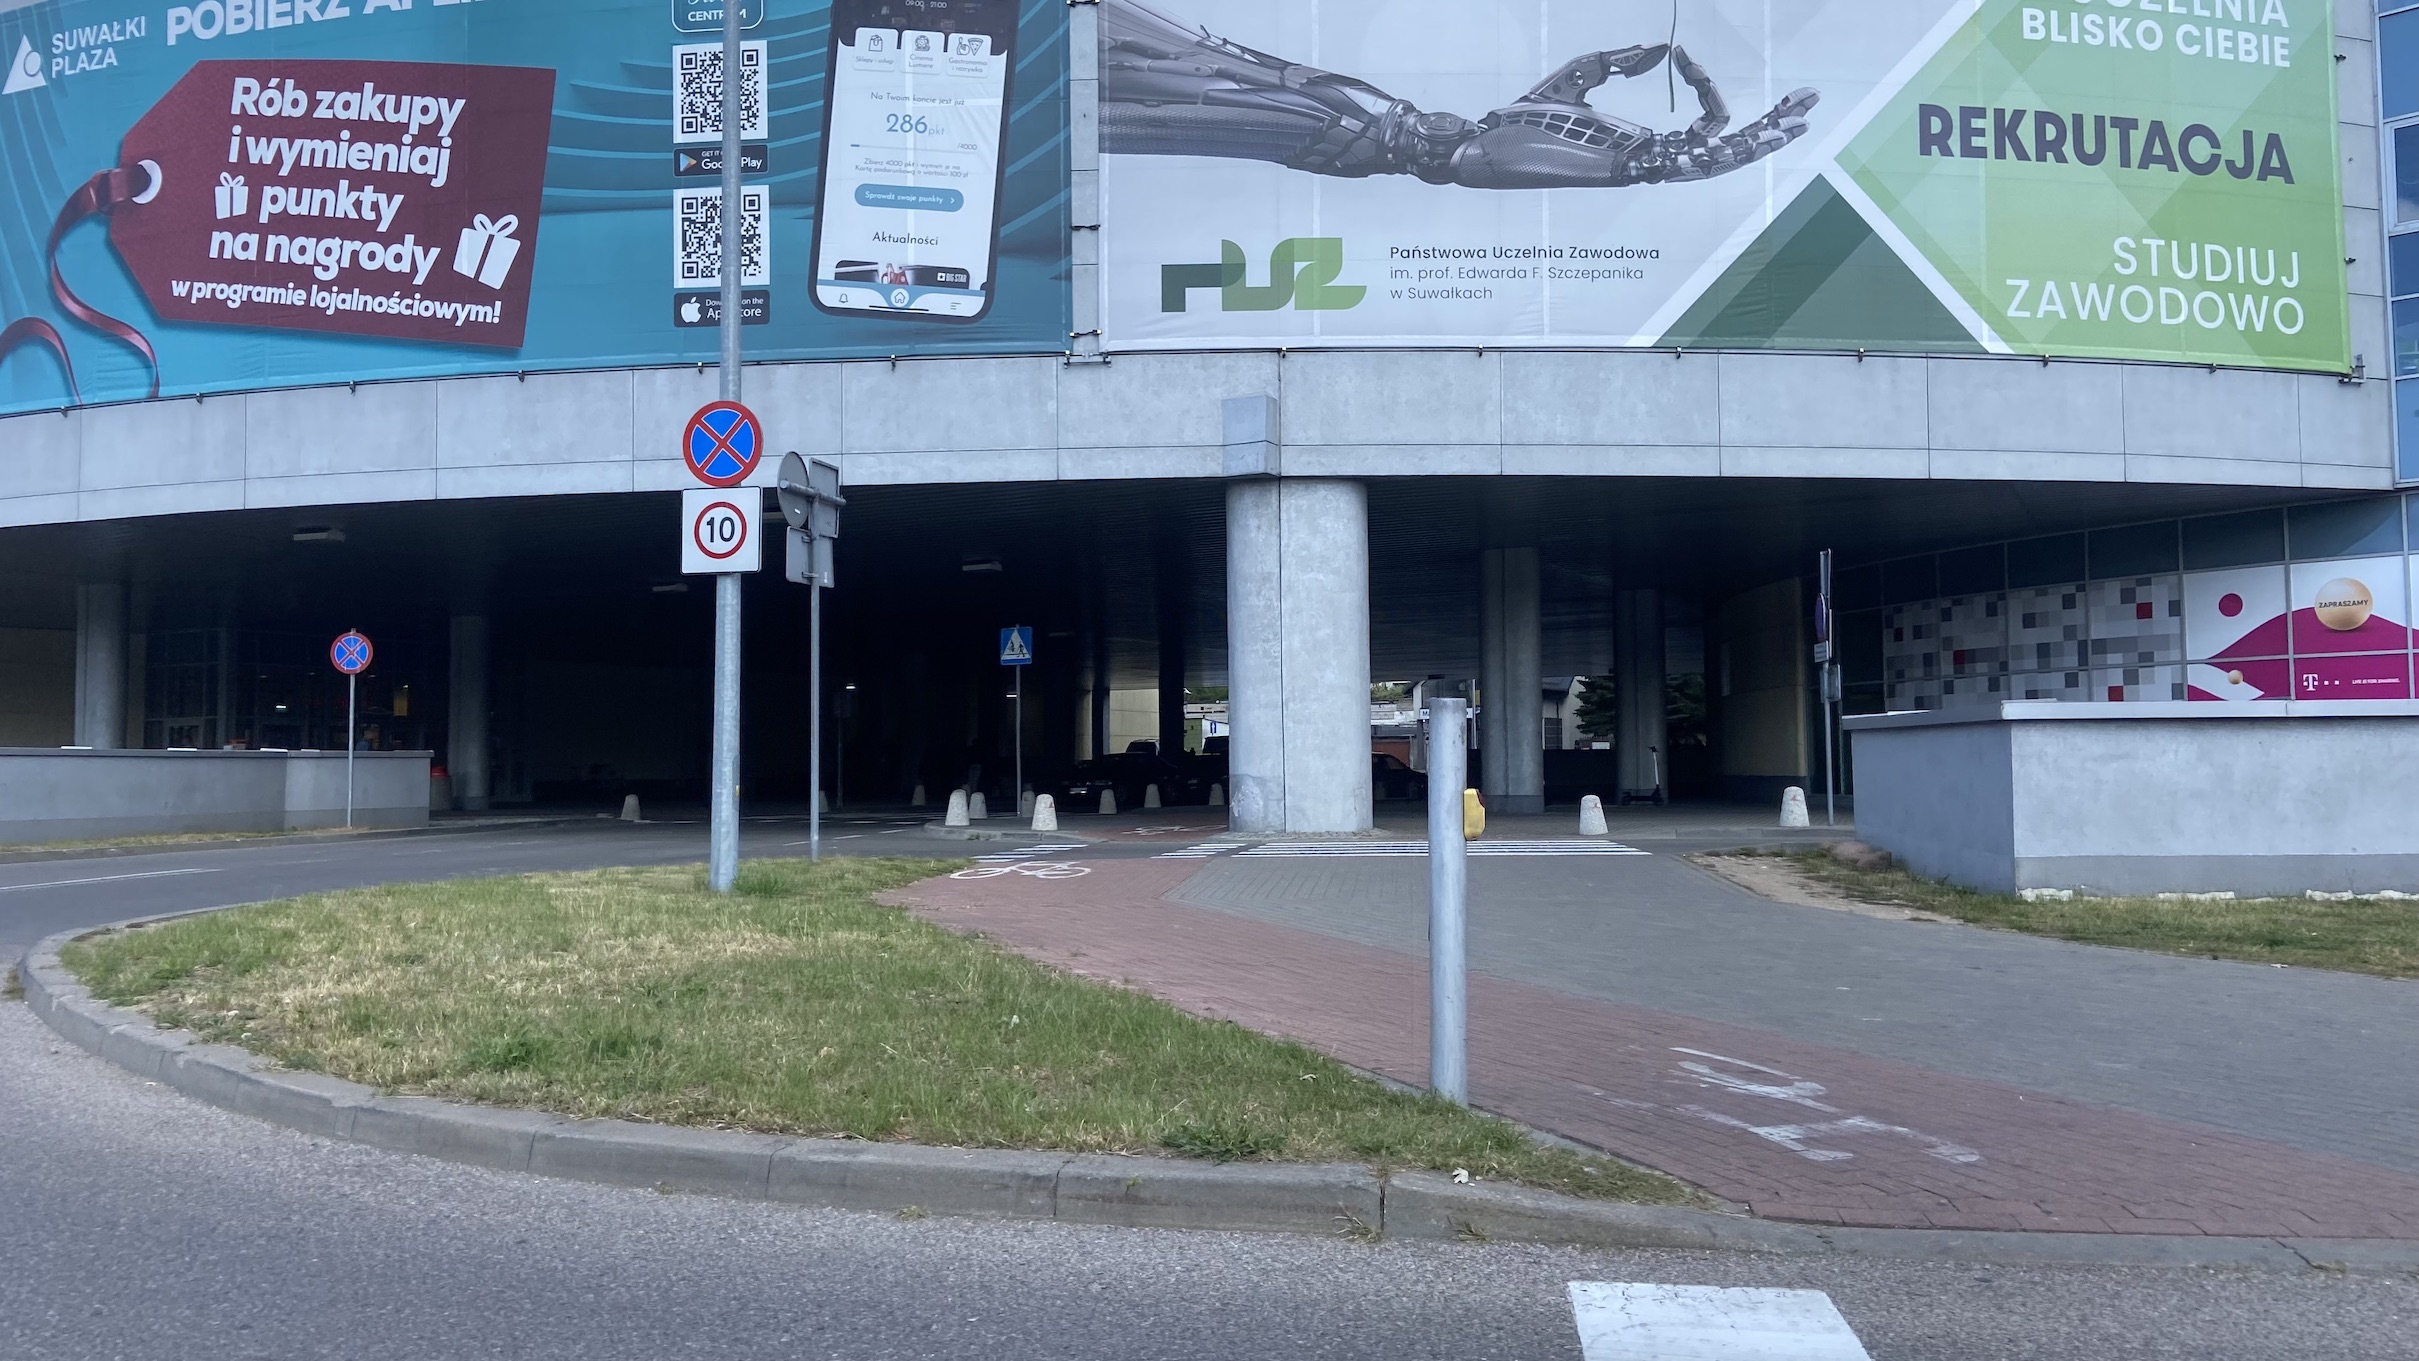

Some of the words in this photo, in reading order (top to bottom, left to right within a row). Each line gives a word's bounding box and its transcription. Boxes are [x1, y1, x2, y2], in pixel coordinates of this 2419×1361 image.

[51, 15, 145, 54] SUWAŁKI
[2023, 8, 2164, 51] BLISKO
[2176, 23, 2291, 67] CIEBIE
[51, 46, 118, 78] PLAZA
[230, 77, 308, 117] Rób
[312, 82, 467, 137] zakupy
[870, 92, 883, 100] Na
[886, 92, 910, 102] Twoim
[912, 94, 936, 103] koncie
[938, 97, 952, 105] jest
[886, 113, 928, 134] 286
[928, 124, 945, 136] pkt
[228, 124, 242, 163] i
[245, 129, 453, 188] wymieniaj
[1918, 103, 2295, 184] REKRUTACJA
[741, 156, 762, 169] Play
[864, 158, 884, 166] Zbierz
[885, 159, 903, 167] 4000
[950, 170, 961, 178] 100
[258, 179, 405, 232] punkty
[918, 195, 944, 205] punkty
[872, 231, 940, 246] Aktualności
[208, 230, 260, 260] na
[264, 233, 442, 285] nagrody
[1390, 244, 1487, 260] Państwowa
[1493, 245, 1563, 259] Uczelnia
[1569, 246, 1659, 260] Zawodowa
[2113, 236, 2300, 288] STUDIUJ
[1390, 266, 1413, 279] im.
[1417, 266, 1453, 283] prof.
[1458, 266, 1527, 279] Edwarda
[1532, 267, 1543, 279] F.
[1548, 266, 1644, 283] Szczepanika
[171, 278, 191, 297] w
[191, 281, 307, 309] programie
[309, 284, 502, 326] lojalnościowym!
[752, 297, 764, 305] the
[1390, 289, 1403, 299] w
[1407, 286, 1493, 300] Suwałkach
[2005, 279, 2304, 335] ZAWODOWO
[706, 516, 736, 543] 10
[2318, 599, 2369, 609] ZAPRASZAMY
